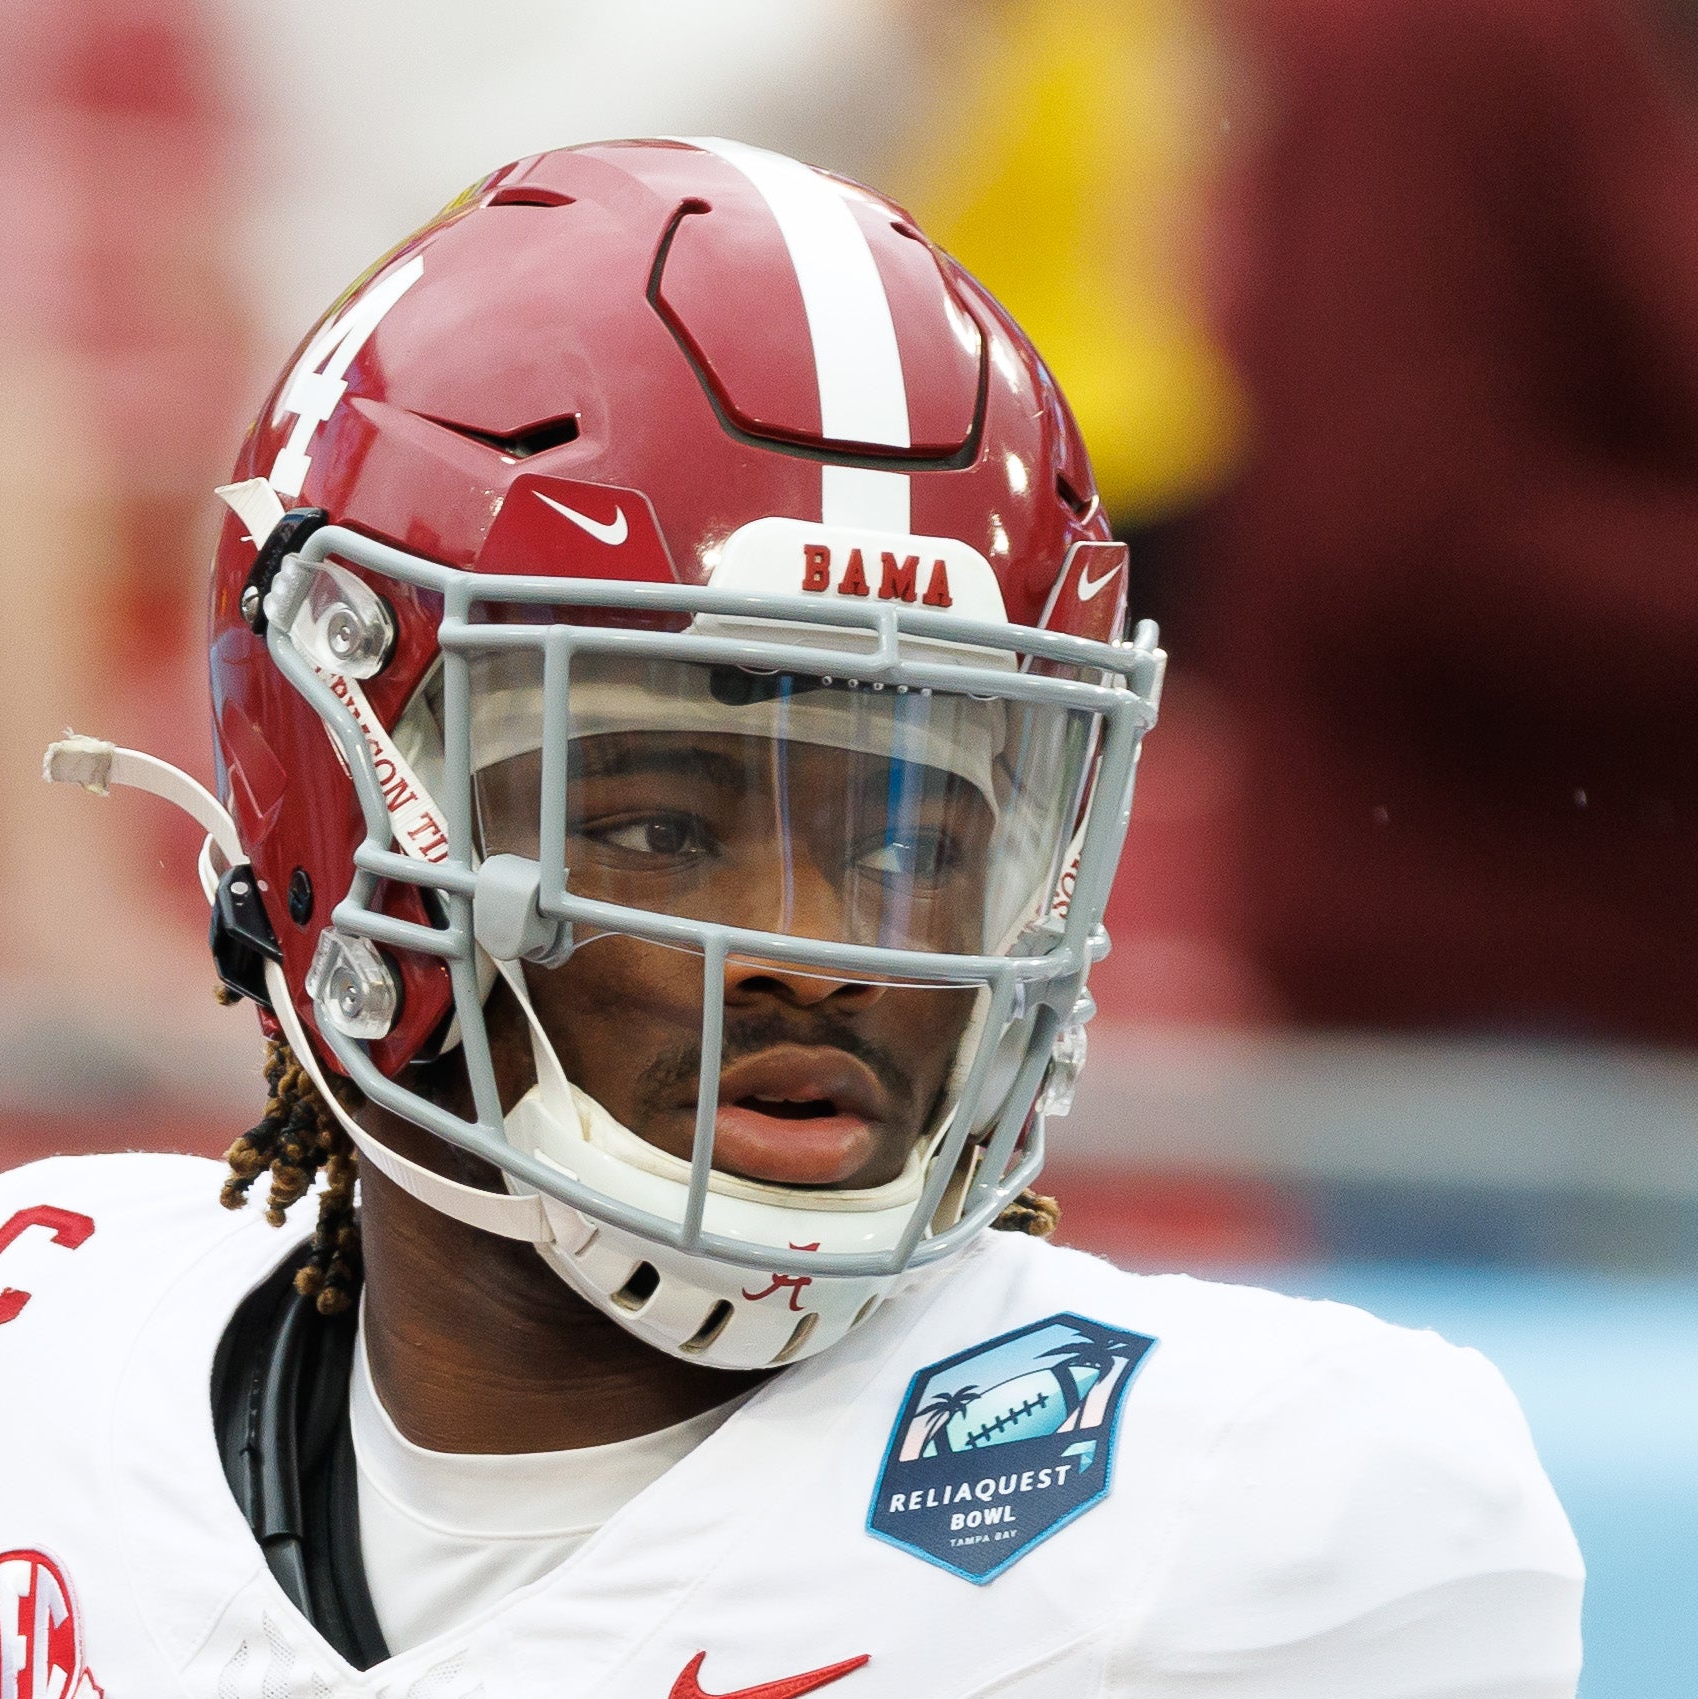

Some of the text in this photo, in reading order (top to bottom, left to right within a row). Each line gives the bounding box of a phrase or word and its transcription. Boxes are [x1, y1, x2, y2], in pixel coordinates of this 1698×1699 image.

[269, 254, 425, 498] 4
[802, 543, 953, 608] BAMA
[889, 1464, 1072, 1513] RELIAQUEST
[950, 1505, 1017, 1531] BOWL
[950, 1529, 1018, 1547] TAMPA BAY
